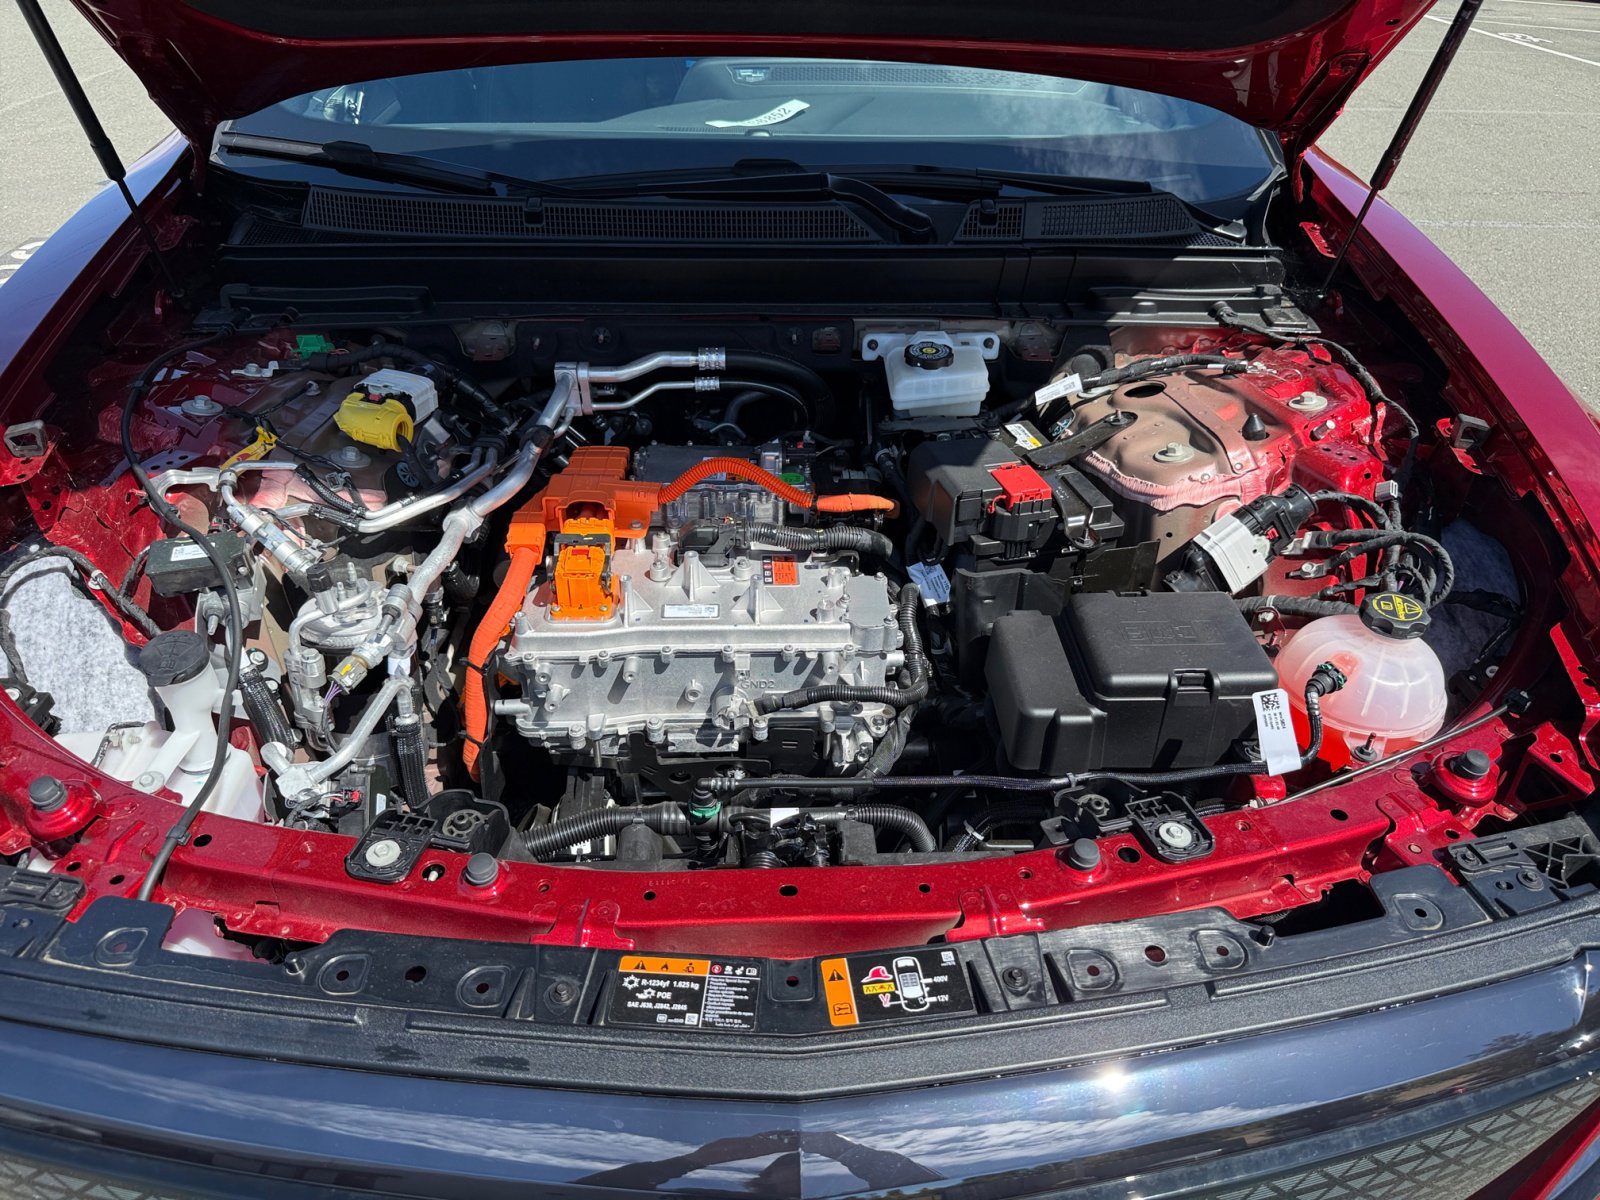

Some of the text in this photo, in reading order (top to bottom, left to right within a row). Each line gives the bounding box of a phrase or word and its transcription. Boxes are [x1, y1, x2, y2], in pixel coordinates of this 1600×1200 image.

[740, 680, 776, 690] GND2
[933, 975, 948, 983] 400V
[690, 981, 700, 991] kg
[656, 991, 672, 1000] POE
[937, 994, 949, 1002] 12V
[627, 1001, 639, 1009] SAE
